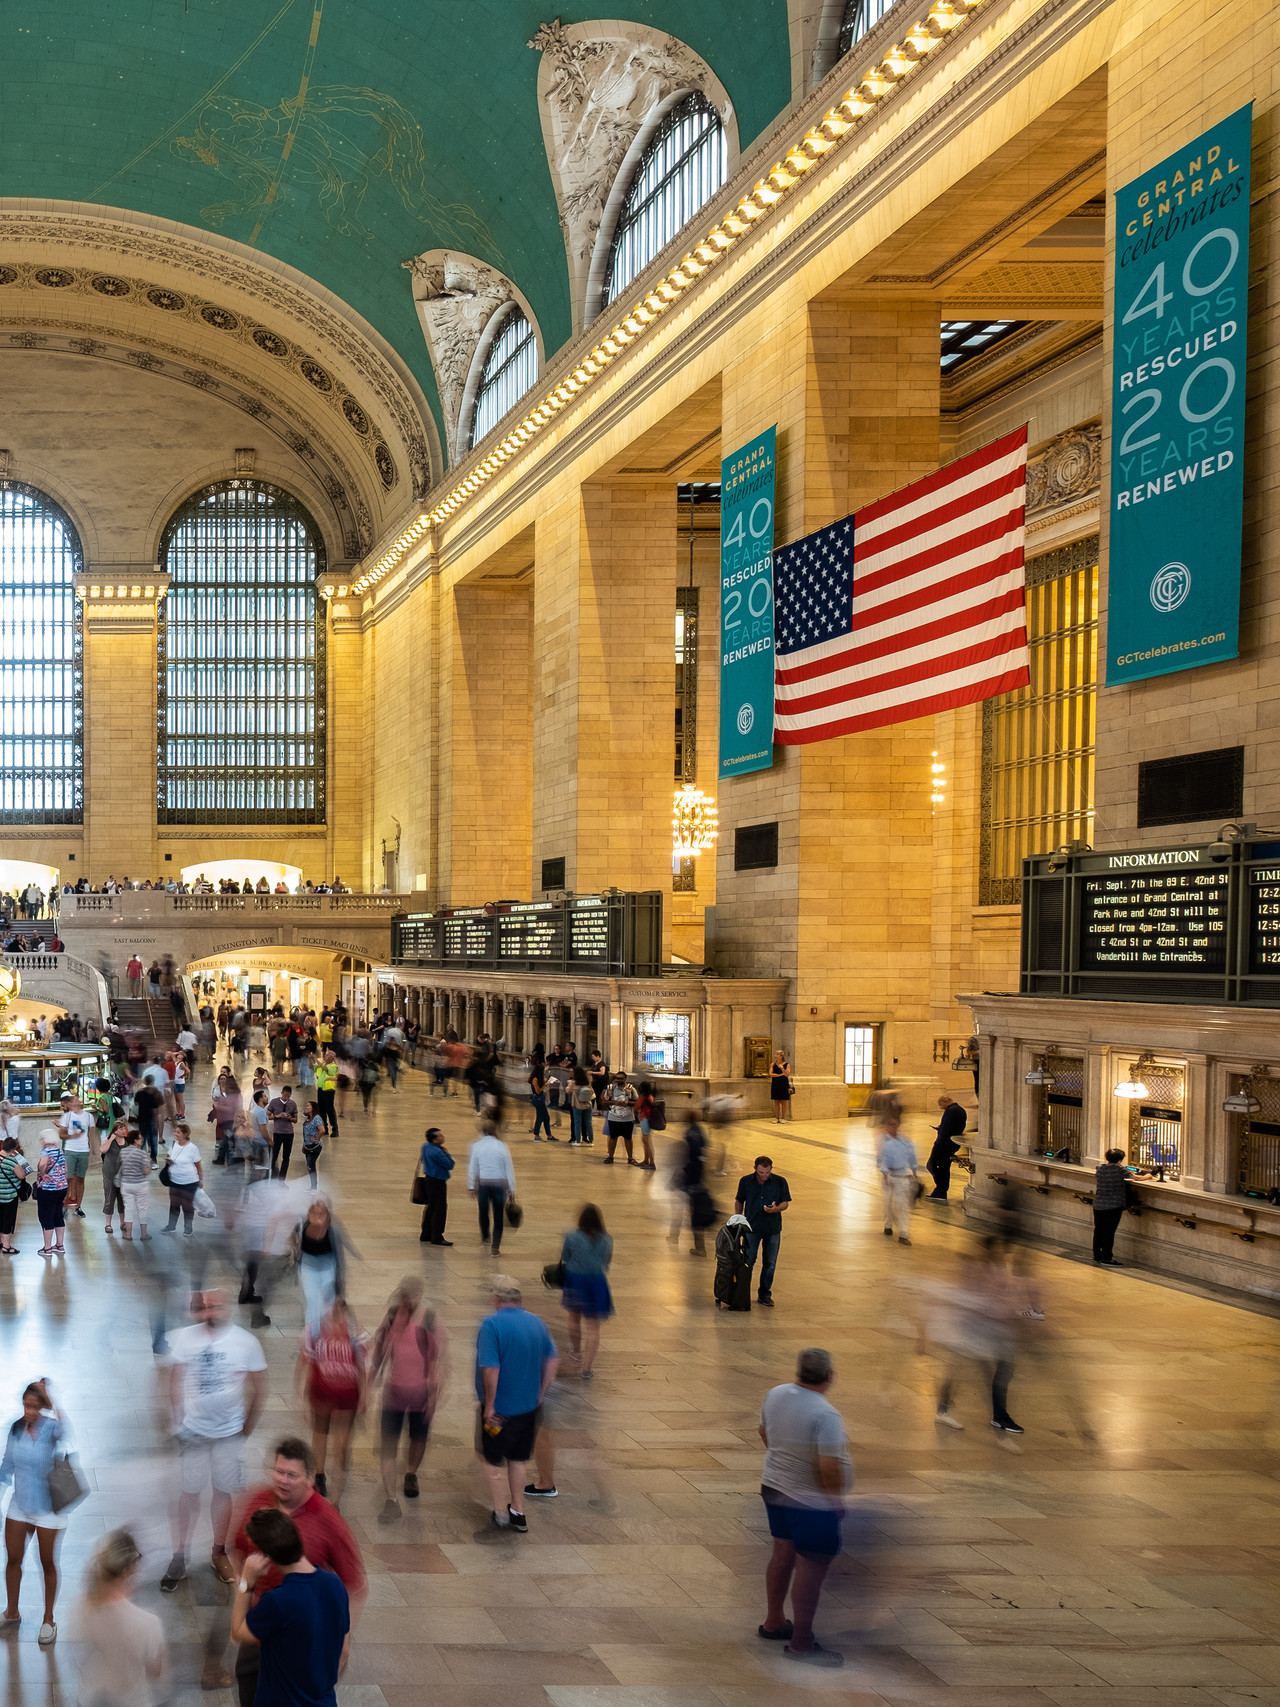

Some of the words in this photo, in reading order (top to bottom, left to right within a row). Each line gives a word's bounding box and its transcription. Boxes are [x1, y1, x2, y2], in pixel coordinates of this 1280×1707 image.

[1137, 145, 1221, 208] GRAND
[1126, 158, 1240, 236] CENTRAL
[1120, 175, 1244, 269] celebrates
[1122, 226, 1240, 327] 40
[1121, 286, 1237, 365] YEARS
[1121, 320, 1237, 391] RESCUED
[1119, 356, 1236, 456] 20
[730, 445, 765, 475] GRAND
[1119, 416, 1235, 483] YEARS
[722, 467, 774, 511] celebrates
[725, 455, 772, 492] CENTRAL
[1117, 450, 1234, 510] RENEWED
[723, 497, 772, 548] 40
[723, 535, 771, 571] YEARS
[723, 557, 771, 590] RESCUED
[723, 577, 772, 631] 20
[724, 615, 771, 650] YEARS
[1116, 631, 1226, 666] GCTcelebrates.com
[723, 636, 771, 666] RENEWED
[723, 749, 768, 768] GCTcelebrates.com
[1109, 850, 1199, 868] INFORMATION
[1087, 882, 1102, 891] Fri.
[1106, 880, 1126, 891] Sept.
[1131, 880, 1145, 889] 7th
[1150, 878, 1163, 888] the
[1180, 877, 1189, 886] E.
[1194, 875, 1214, 885] 42nd
[1218, 874, 1228, 884] St
[1094, 895, 1127, 904] entrance
[1131, 894, 1142, 903] of
[1143, 893, 1167, 903] Grand
[1170, 891, 1204, 901] Central
[1208, 891, 1219, 900] at
[1259, 888, 1280, 898] 12:2
[1089, 924, 1114, 933] closed
[1118, 923, 1136, 932] from
[1188, 922, 1204, 931] Use
[1208, 922, 1223, 931] 105
[1094, 909, 1110, 919] Park
[1114, 908, 1127, 918] Ave
[1130, 908, 1144, 918] and
[1148, 907, 1167, 917] 42nd
[1170, 907, 1180, 917] St
[1184, 906, 1203, 916] will
[1208, 906, 1219, 916] be
[1258, 920, 1280, 931] 12:5
[212, 938, 258, 953] LEXINGTON
[259, 936, 275, 944] AVE
[301, 937, 328, 946] TICKET
[330, 940, 369, 955] MACHINES
[1096, 952, 1138, 962] Vanderbilt
[1142, 952, 1156, 962] Ave
[1101, 938, 1106, 947] E
[1109, 938, 1126, 947] 42nd
[1130, 938, 1139, 947] St
[1142, 939, 1152, 947] or
[1156, 938, 1176, 947] 42nd
[1179, 938, 1188, 947] St
[1192, 938, 1208, 947] and
[1262, 936, 1280, 947] 1:1
[194, 961, 217, 970] STREET
